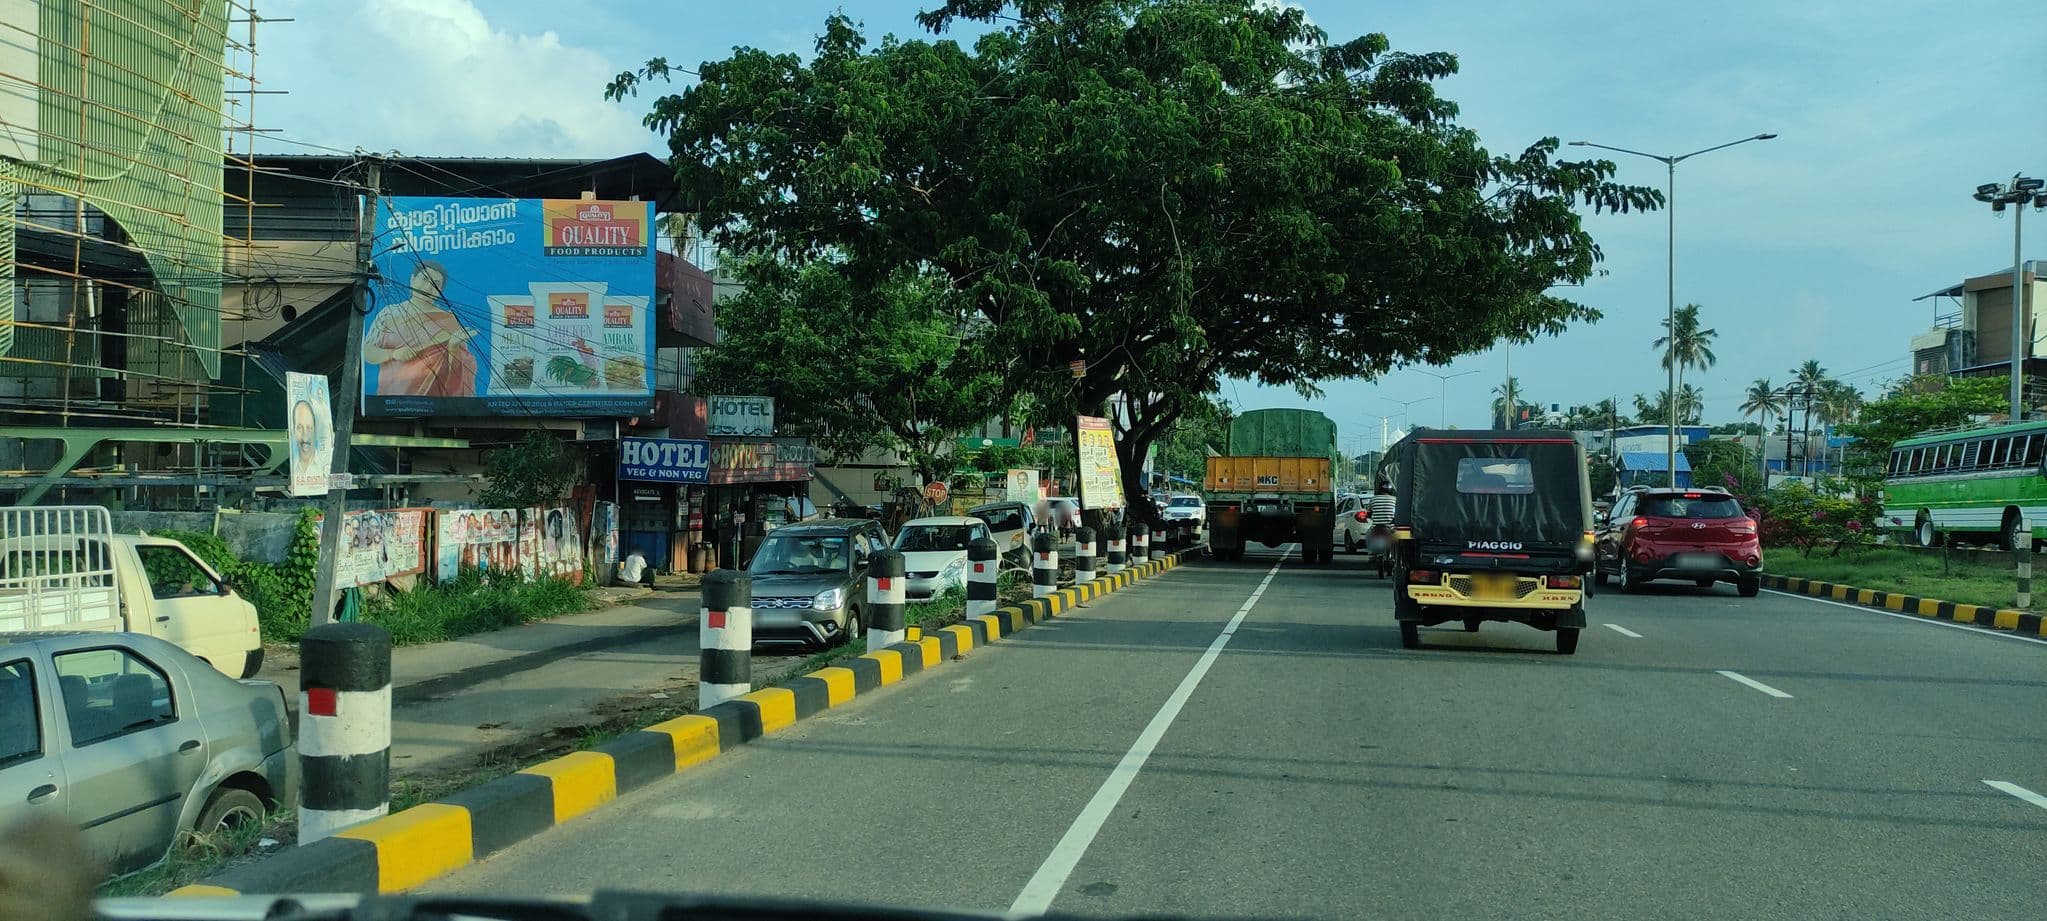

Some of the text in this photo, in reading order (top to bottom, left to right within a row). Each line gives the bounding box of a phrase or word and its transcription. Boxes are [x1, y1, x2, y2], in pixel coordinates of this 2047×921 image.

[562, 226, 631, 246] QUALITY
[555, 306, 582, 315] QUALITY
[713, 401, 770, 416] HOTEL
[622, 441, 708, 468] HOTEL
[720, 444, 757, 469] HOTEL
[627, 468, 702, 479] VEG & NON VEG
[1257, 476, 1278, 484] MKC
[927, 489, 945, 498] STOP
[1468, 541, 1523, 550] PIAGGIO
